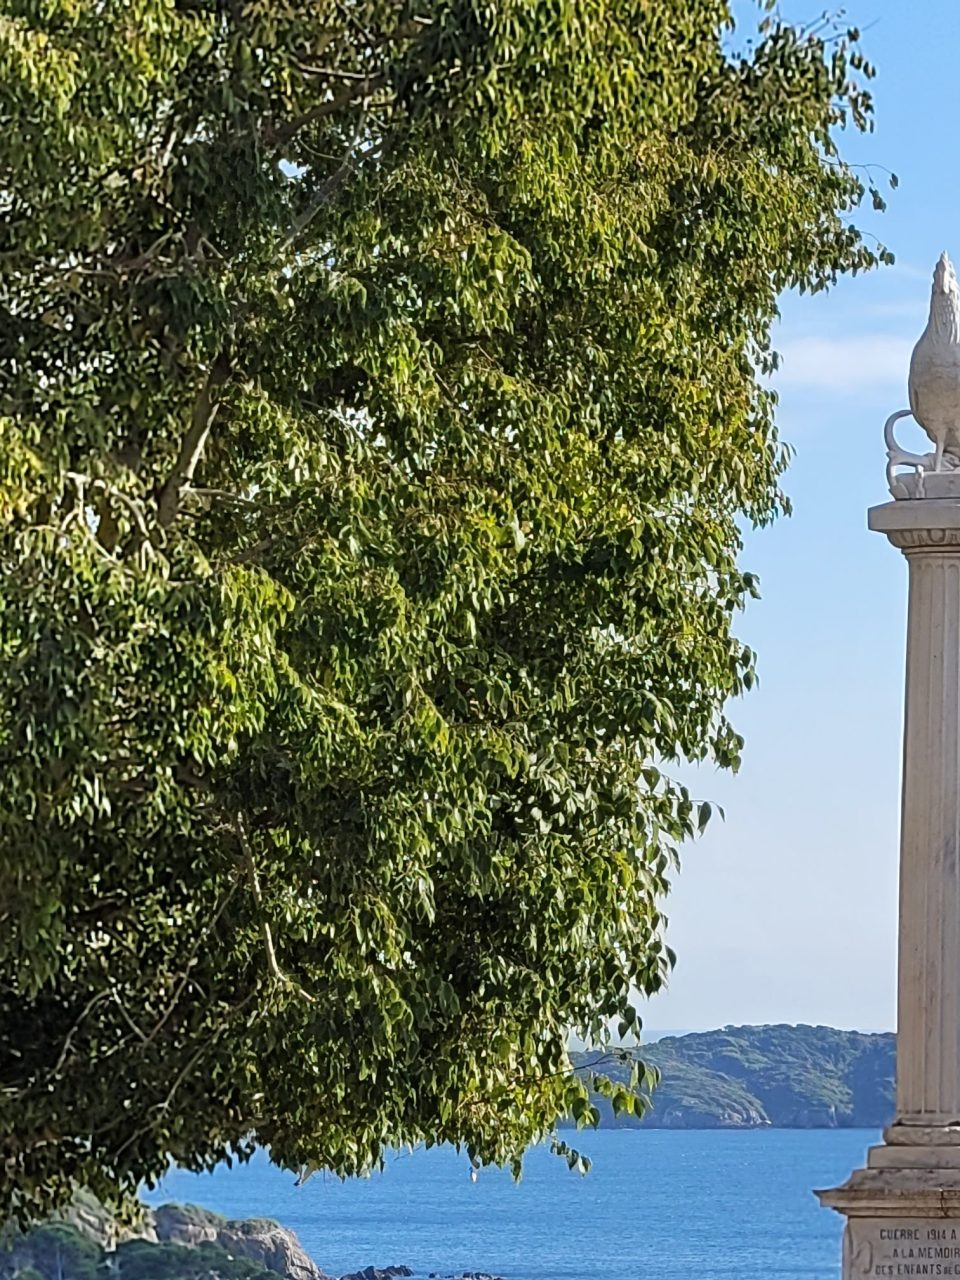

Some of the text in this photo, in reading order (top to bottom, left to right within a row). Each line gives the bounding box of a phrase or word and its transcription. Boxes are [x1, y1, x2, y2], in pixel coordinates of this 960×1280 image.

[880, 1229, 919, 1240] GUERRE
[927, 1229, 946, 1240] 1914
[951, 1229, 956, 1240] A
[893, 1248, 898, 1257] A
[902, 1248, 914, 1258] LA
[876, 1265, 893, 1275] DES
[898, 1264, 941, 1275] ENFANTS
